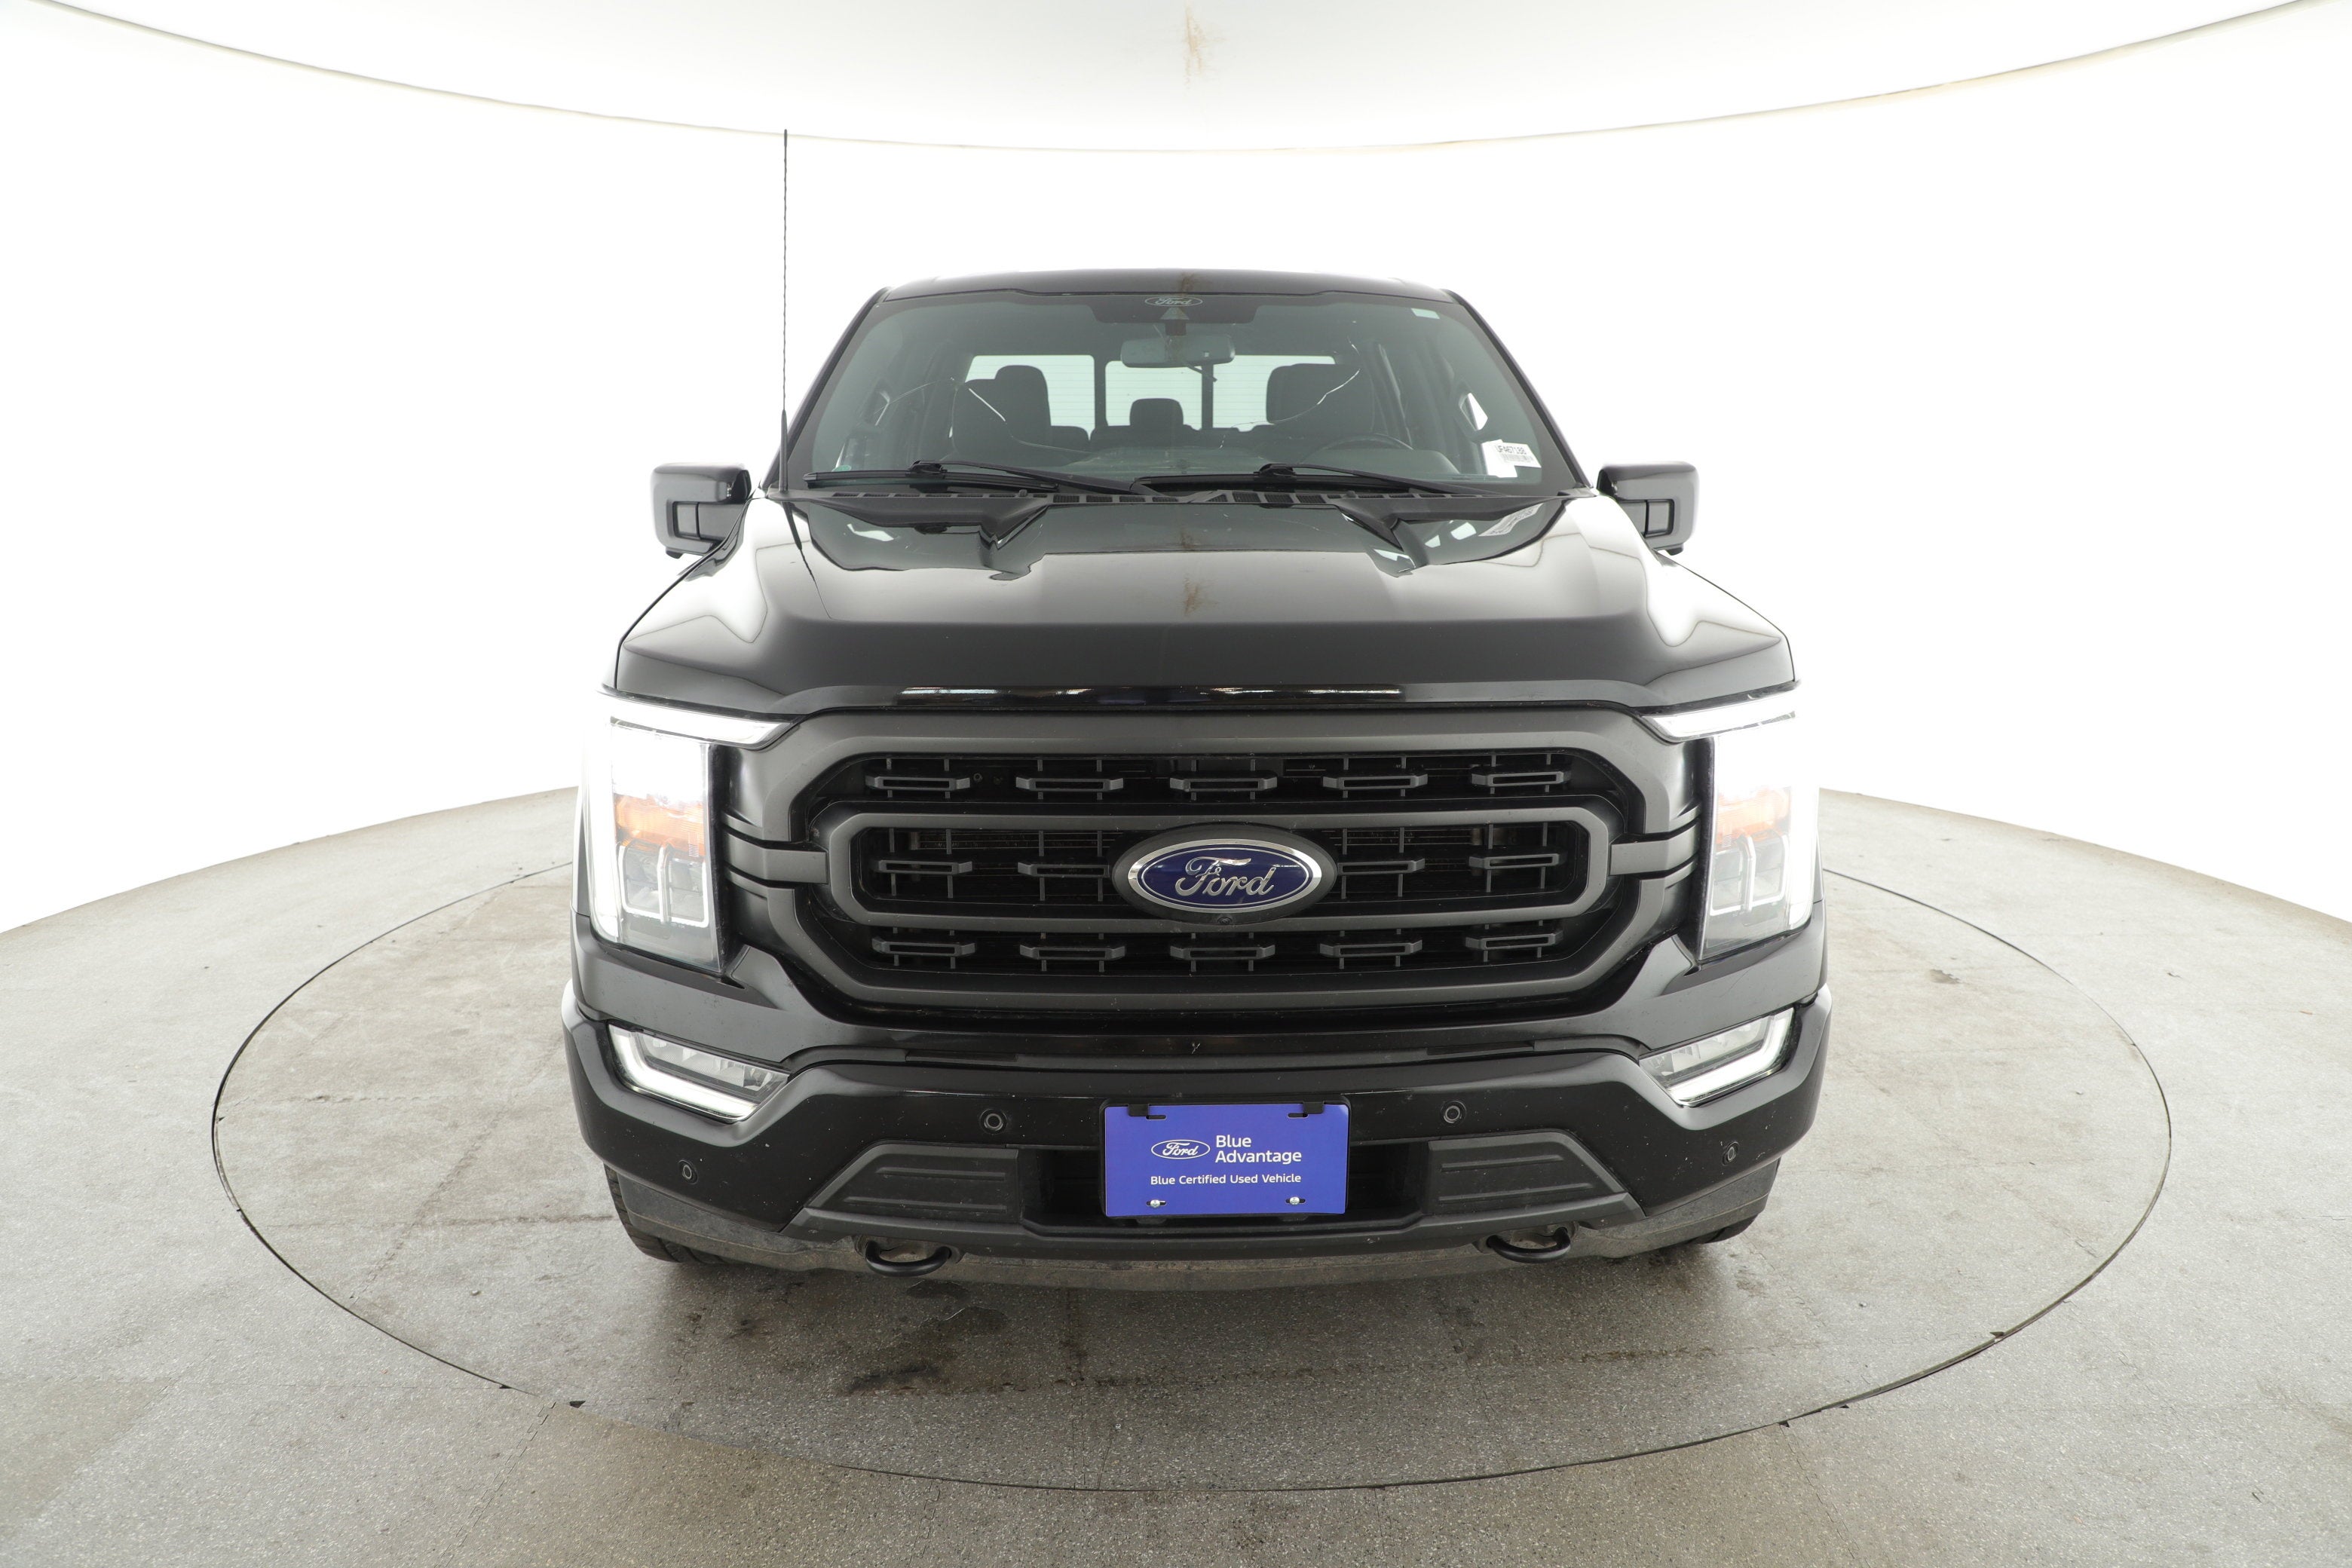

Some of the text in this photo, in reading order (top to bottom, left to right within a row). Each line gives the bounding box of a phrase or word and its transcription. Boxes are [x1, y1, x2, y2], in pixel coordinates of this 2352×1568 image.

[1155, 296, 1192, 305] Ford
[1174, 856, 1277, 896] Ford
[1162, 1141, 1199, 1156] Ford
[1215, 1135, 1251, 1148] Blue
[1215, 1150, 1302, 1165] Advantage
[1150, 1173, 1301, 1185] Blue Certified Used Vehicle
